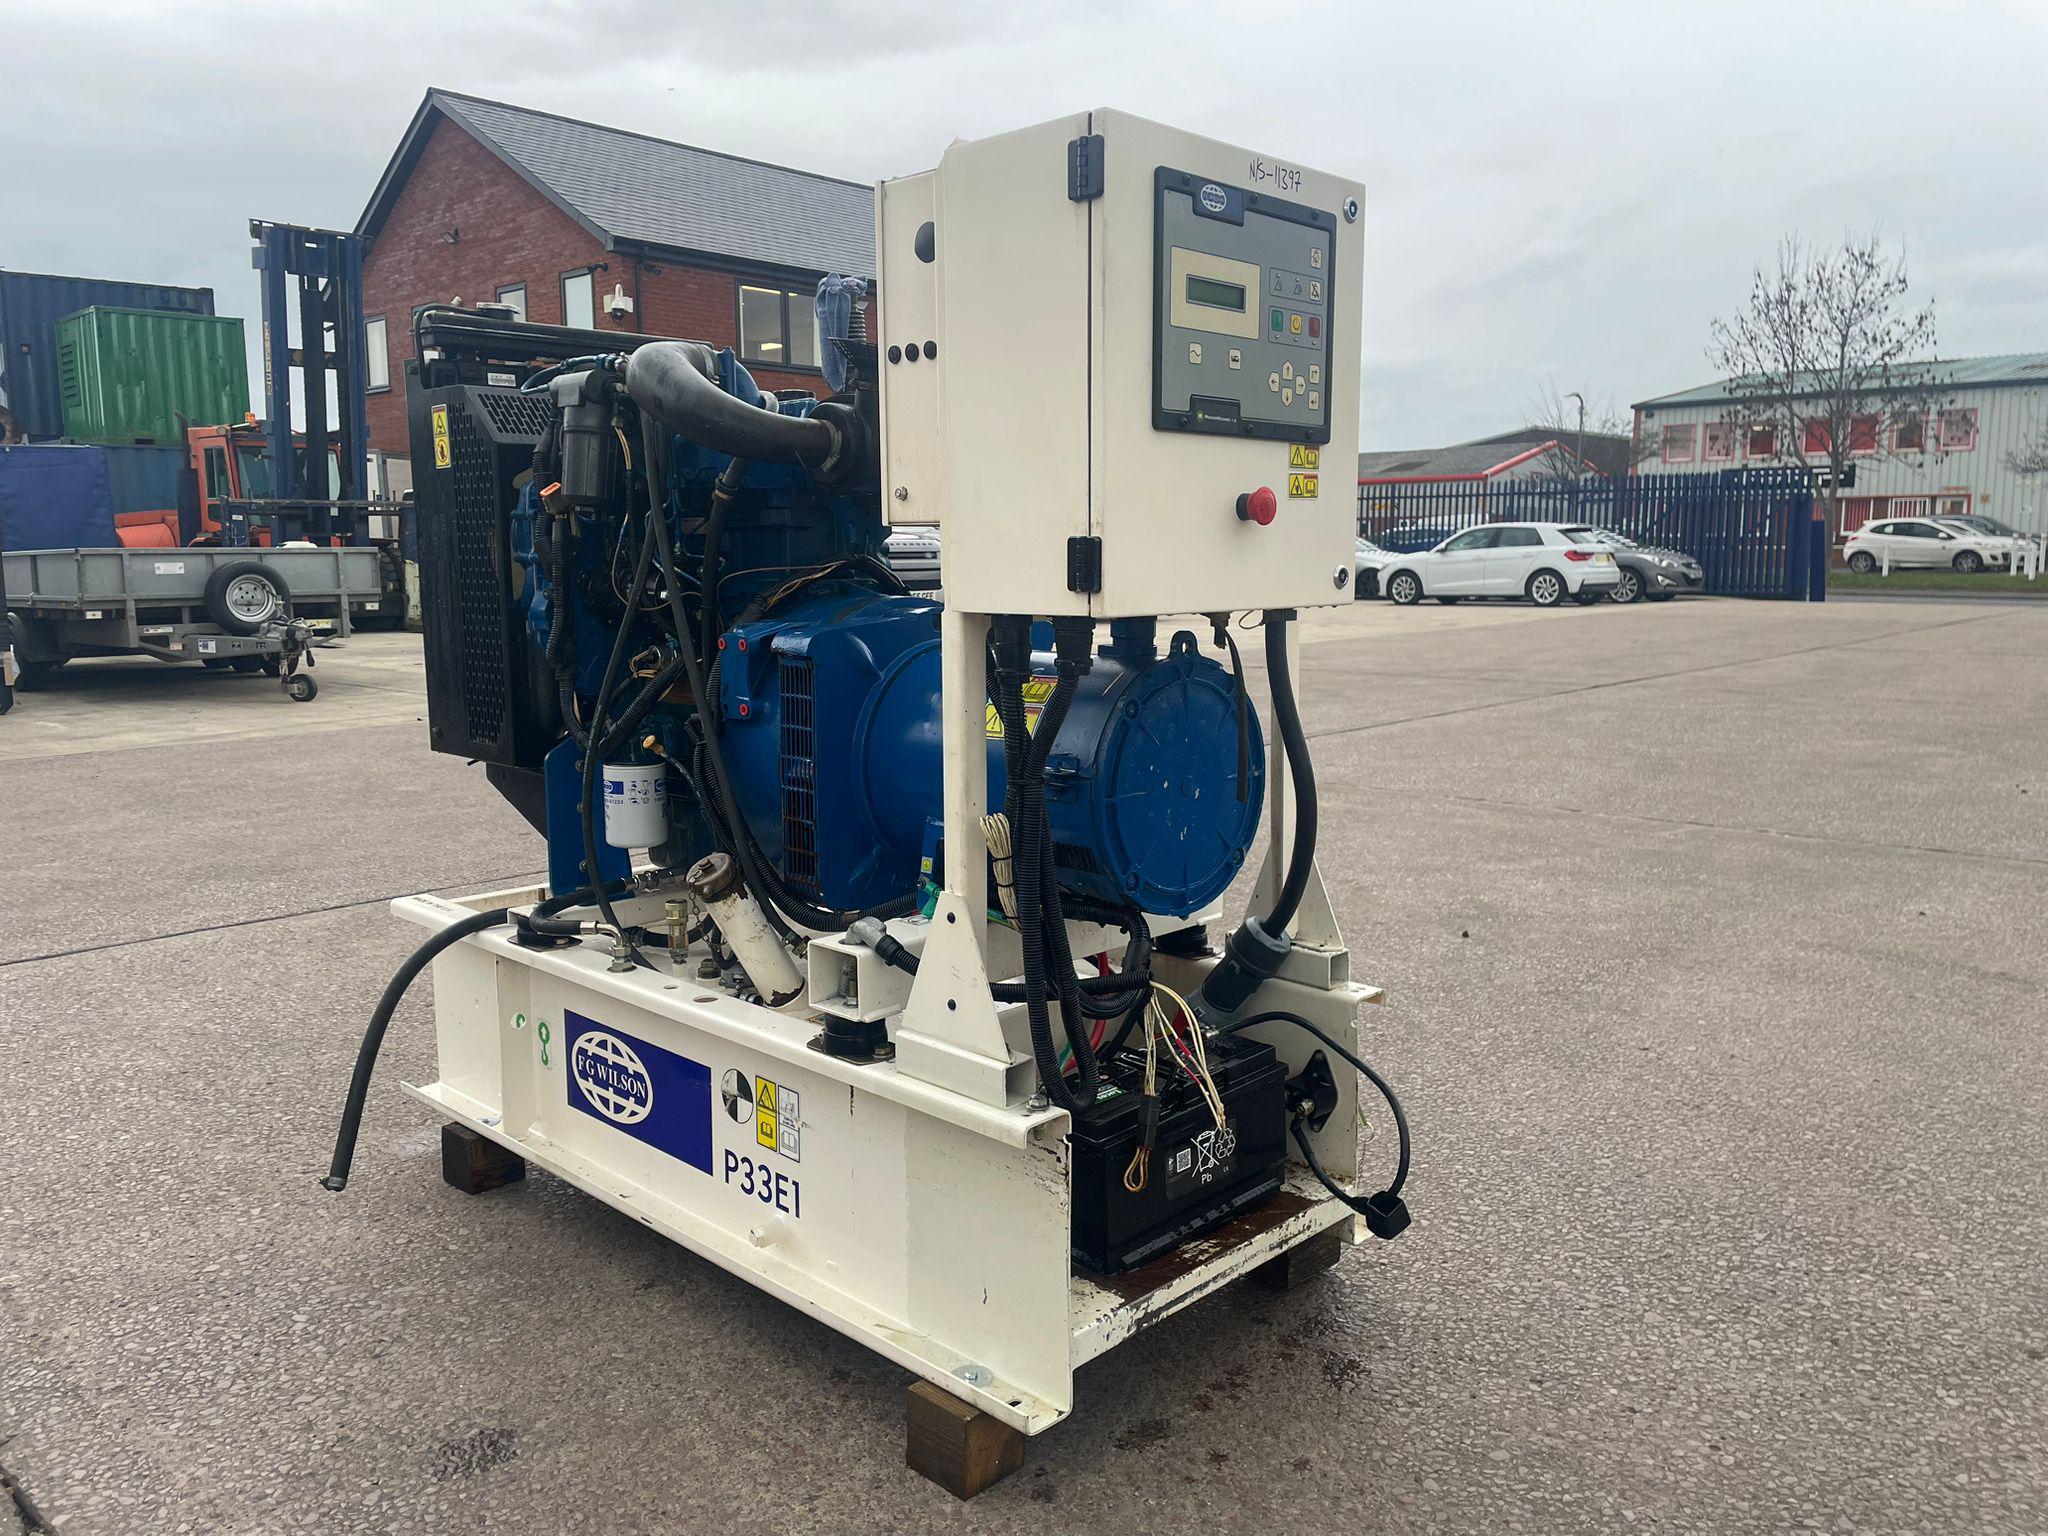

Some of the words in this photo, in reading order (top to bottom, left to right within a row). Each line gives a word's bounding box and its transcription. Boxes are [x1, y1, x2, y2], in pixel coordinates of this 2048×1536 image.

[596, 1063, 646, 1100] WILSON
[724, 1148, 800, 1219] P33E1
[1201, 1172, 1213, 1184] Pb
